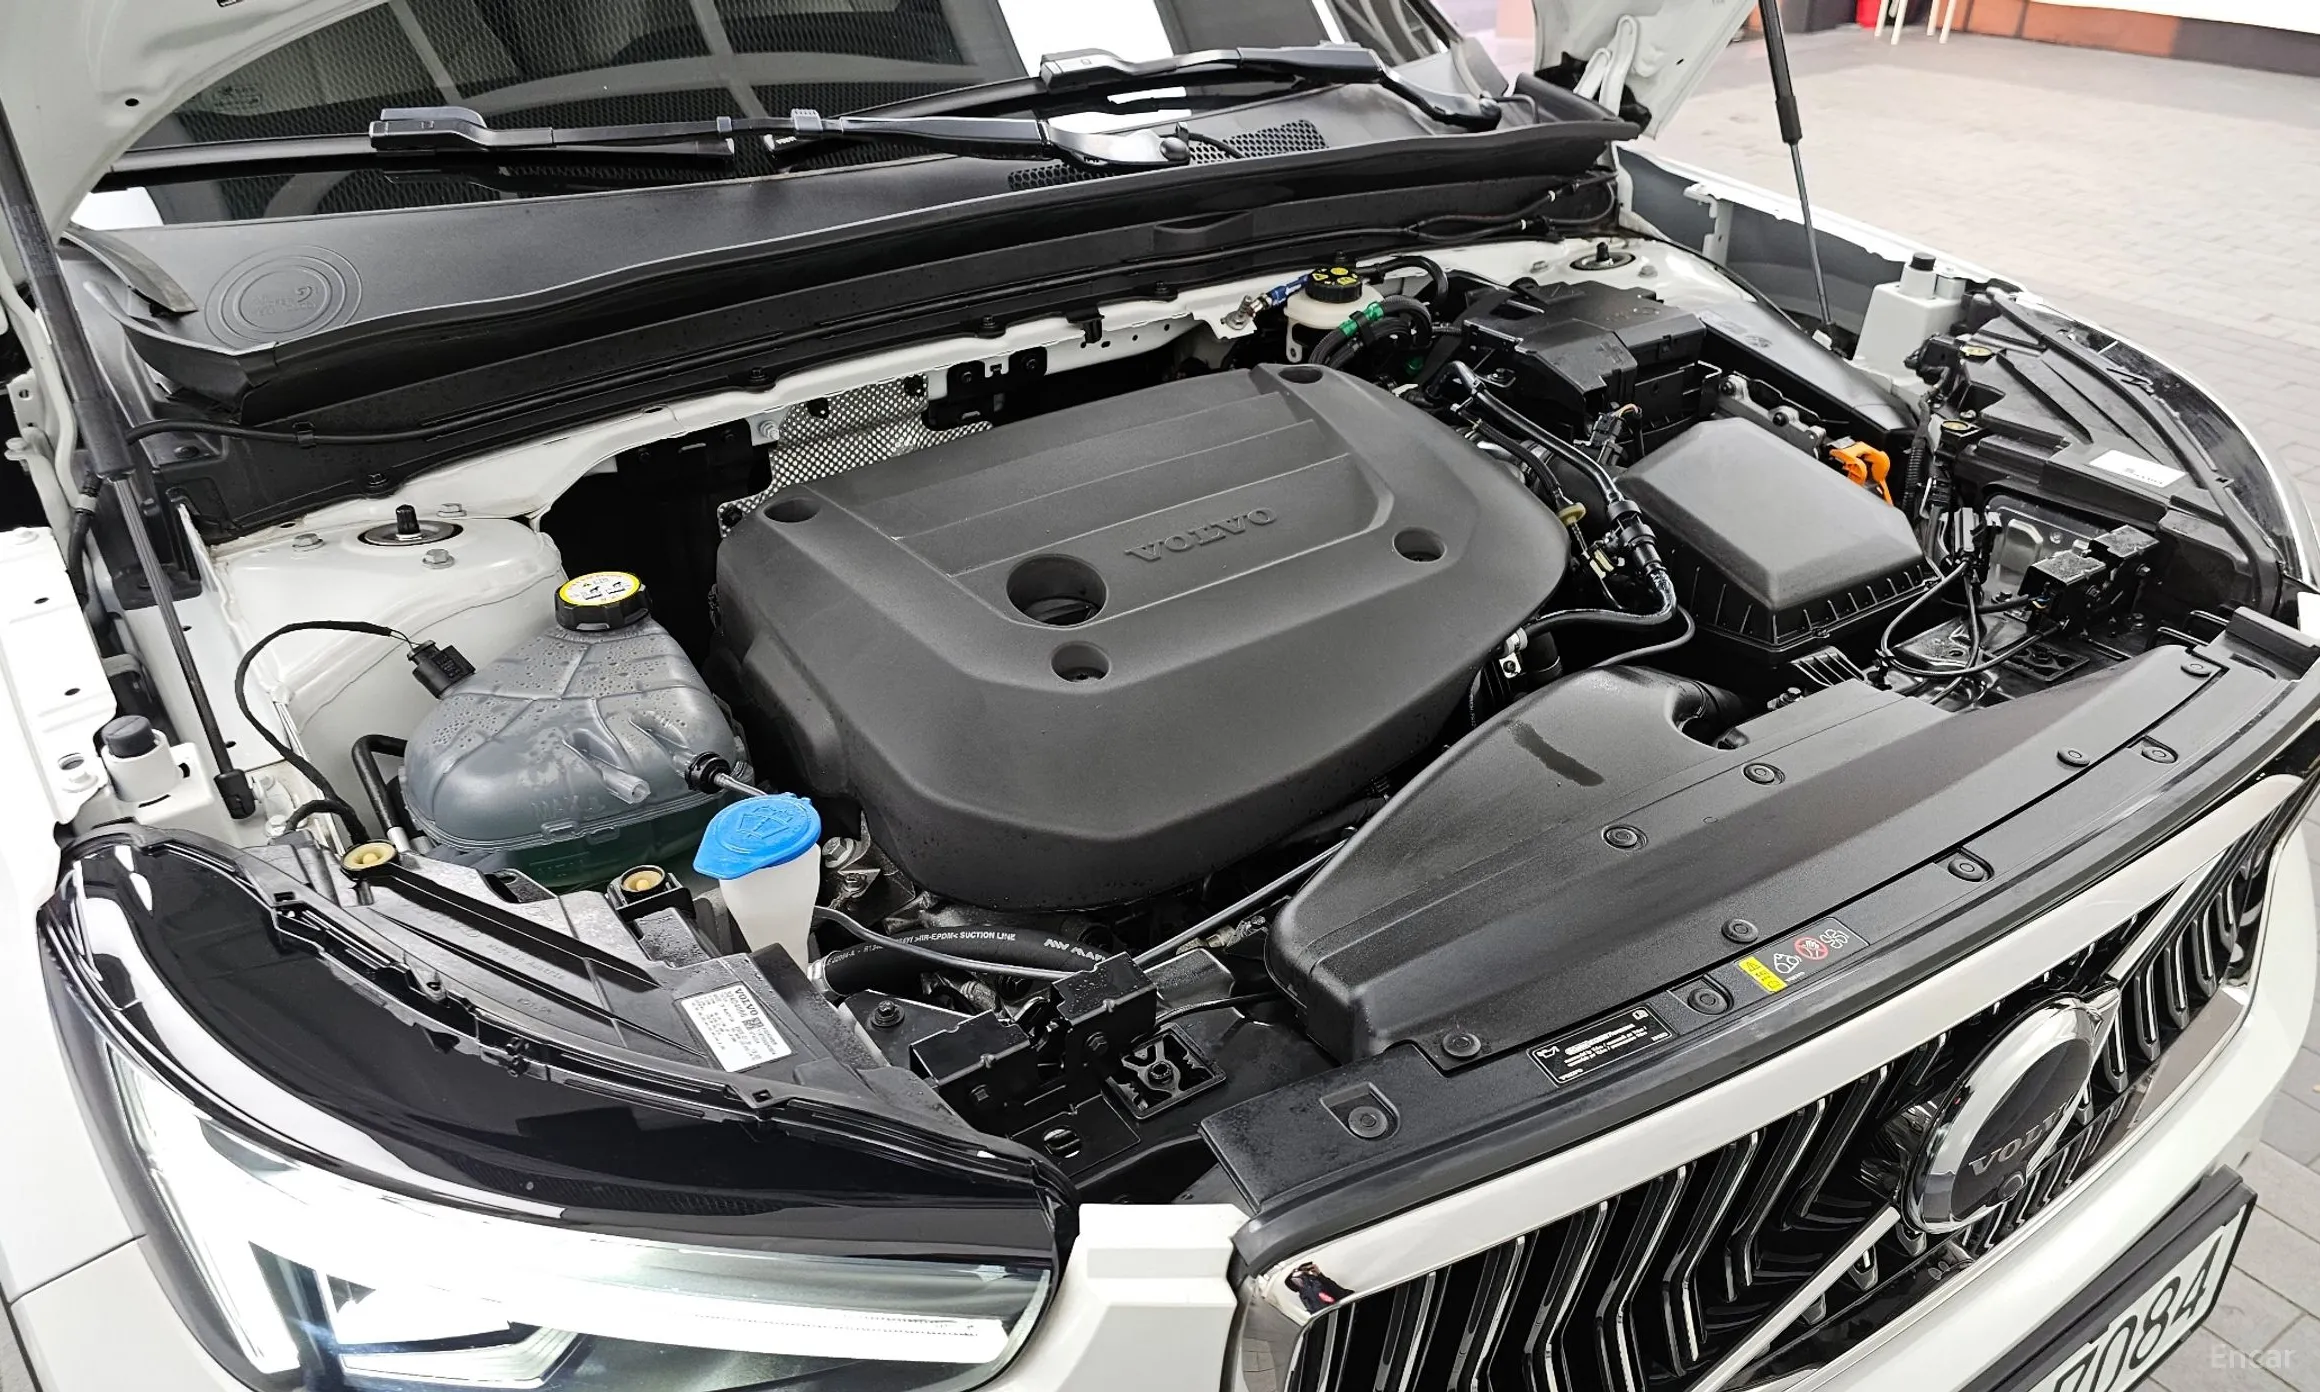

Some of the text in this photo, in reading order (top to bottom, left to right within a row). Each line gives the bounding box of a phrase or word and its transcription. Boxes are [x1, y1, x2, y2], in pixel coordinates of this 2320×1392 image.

[1124, 507, 1277, 562] VOLVO
[960, 931, 995, 939] SUCTION
[996, 931, 1016, 941] LINE
[735, 988, 758, 1016] VOLVO
